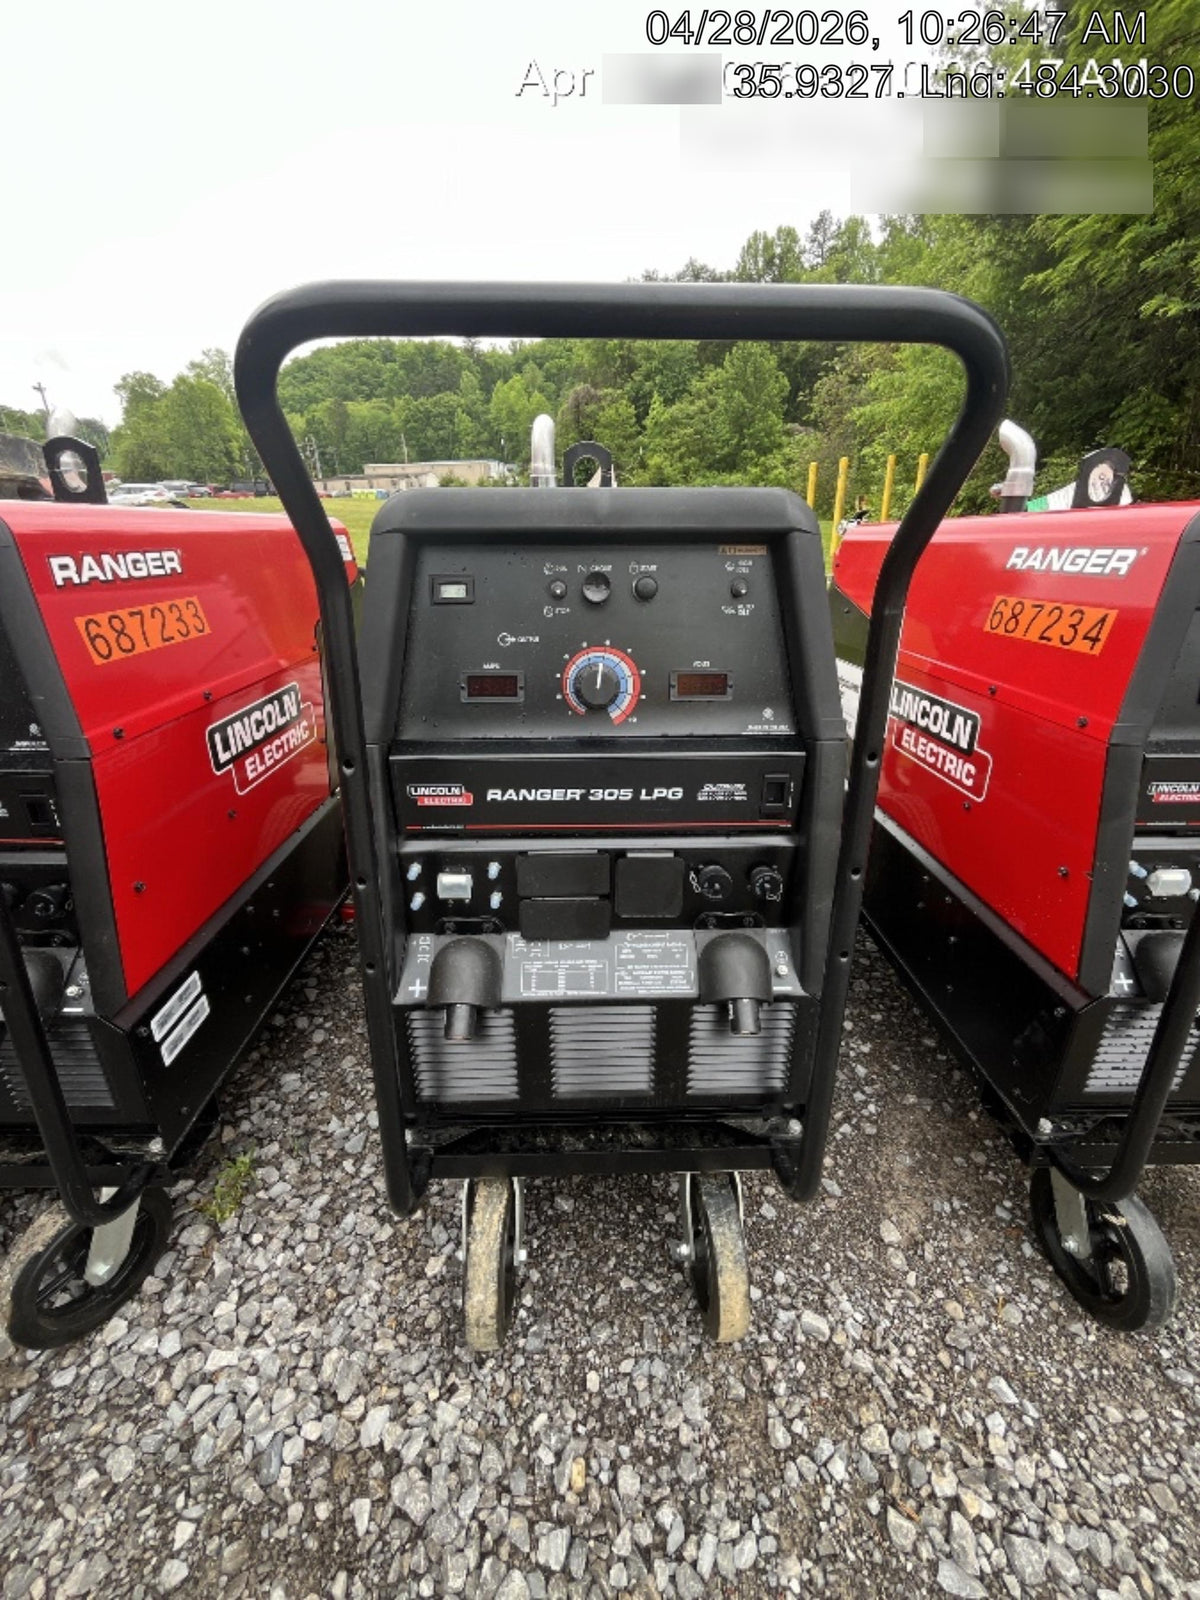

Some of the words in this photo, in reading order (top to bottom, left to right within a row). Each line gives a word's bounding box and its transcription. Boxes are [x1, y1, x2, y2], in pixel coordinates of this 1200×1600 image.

[48, 549, 183, 587] RANGER
[1005, 546, 1139, 576] RANGER
[84, 600, 206, 660] 687233
[989, 598, 1110, 652] 687234
[214, 690, 298, 764] LINCOLN
[891, 686, 973, 750] LINCOLN
[245, 719, 310, 781] ELECTRIC
[900, 728, 976, 787] ELECTRIC
[410, 786, 461, 796] LINCOLN
[486, 788, 583, 802] RANGER
[587, 787, 634, 801] 305
[639, 787, 684, 800] LPG
